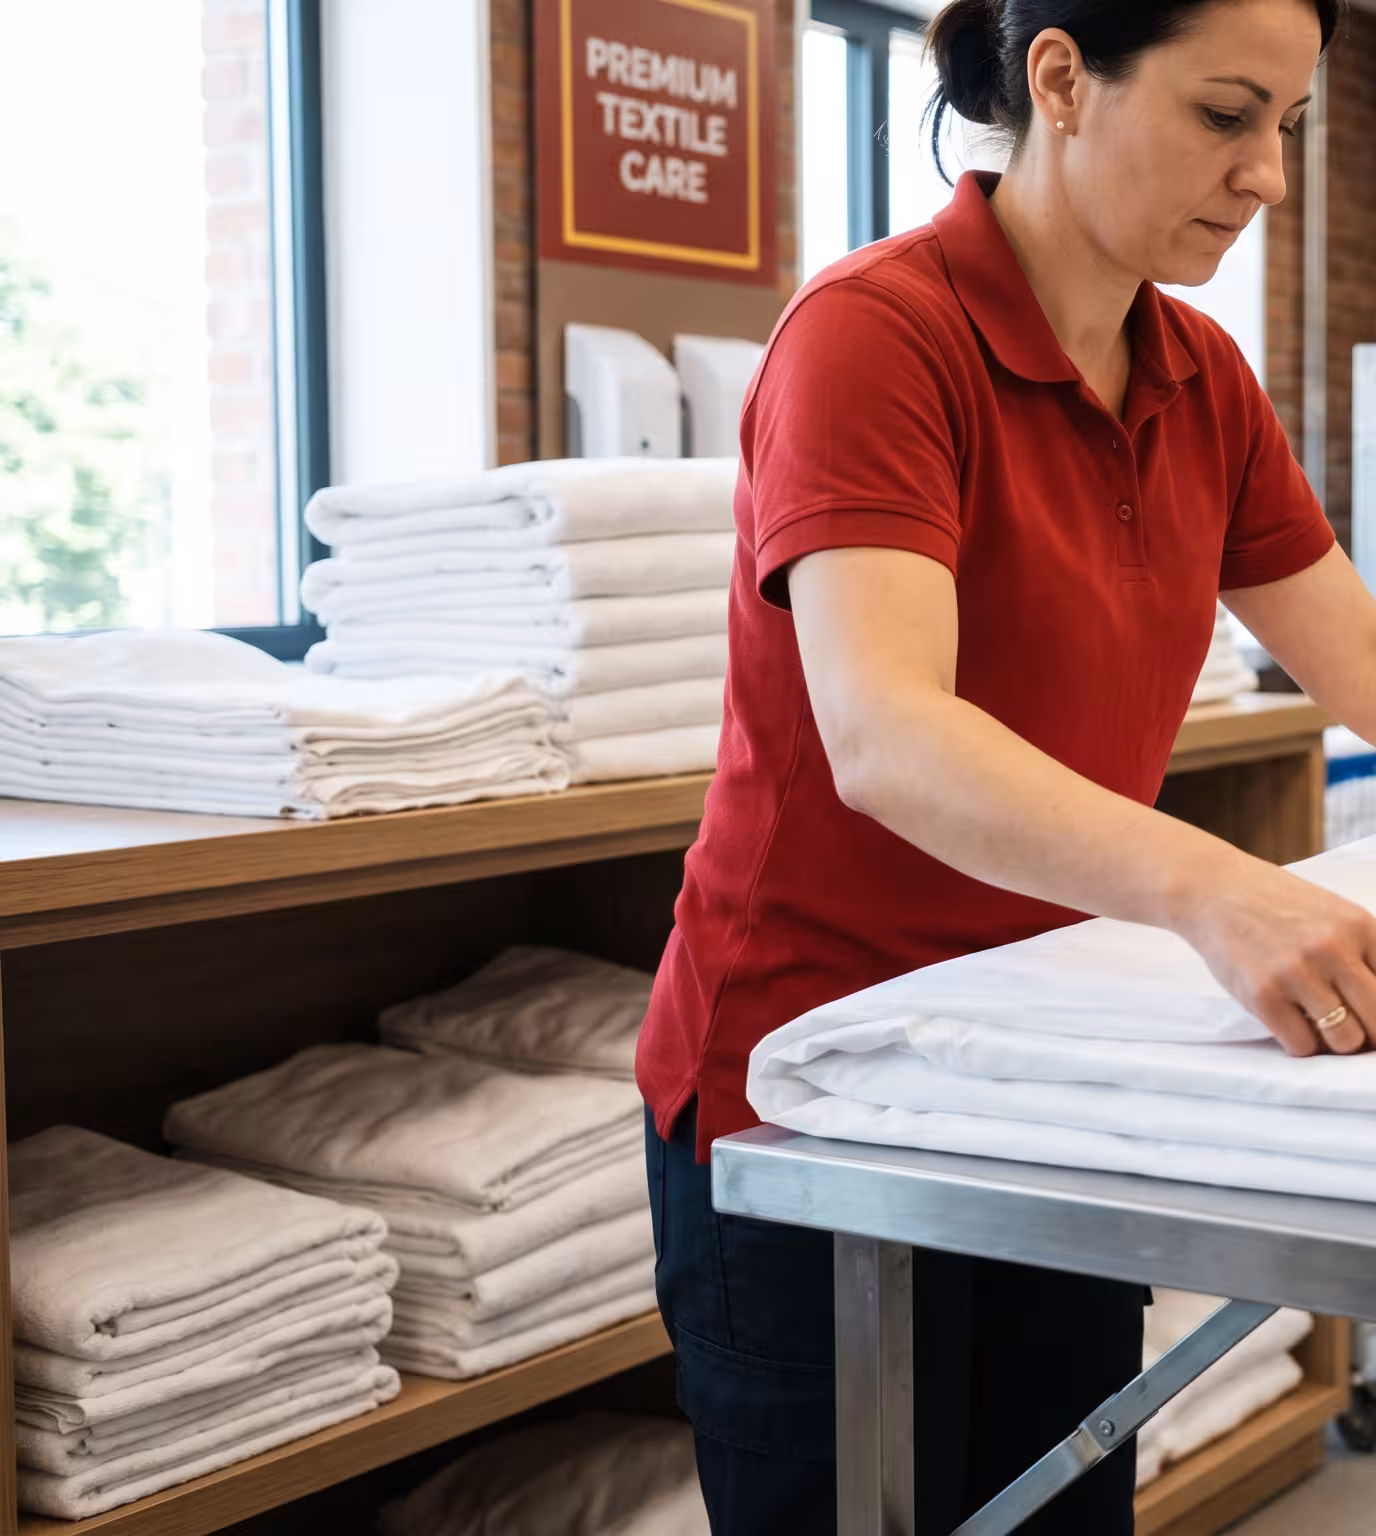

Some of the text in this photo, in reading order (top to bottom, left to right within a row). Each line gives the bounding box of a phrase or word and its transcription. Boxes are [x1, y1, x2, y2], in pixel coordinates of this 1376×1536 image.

[585, 36, 737, 109] PREMIUM
[596, 91, 728, 156] TEXTILE
[619, 149, 708, 203] CARE
